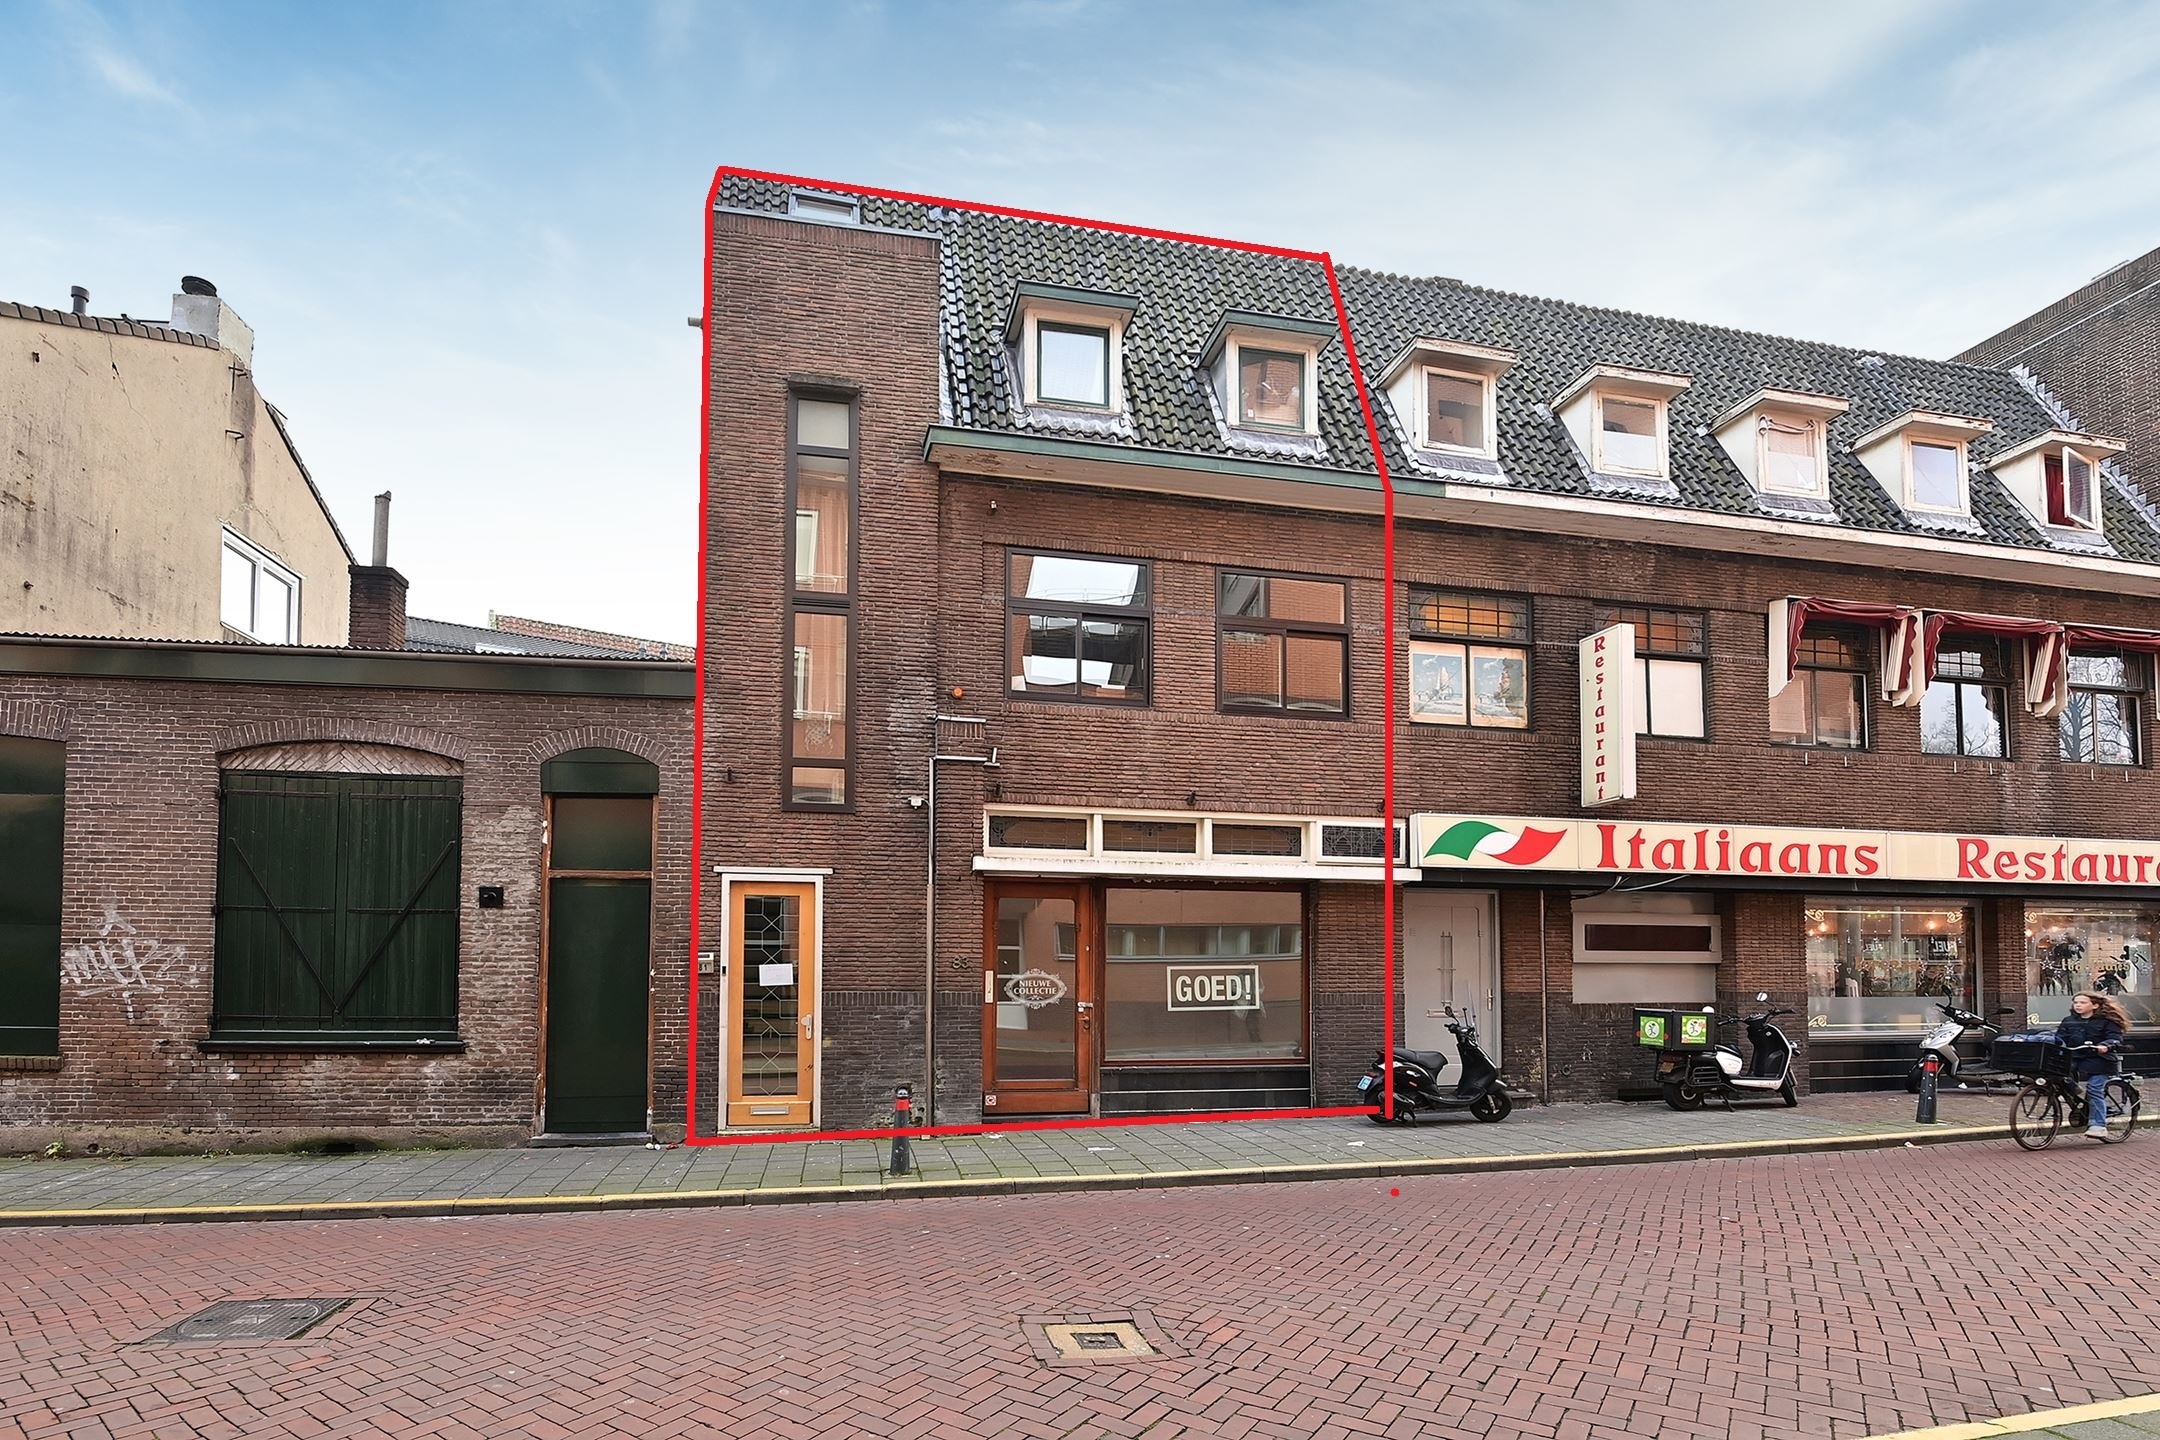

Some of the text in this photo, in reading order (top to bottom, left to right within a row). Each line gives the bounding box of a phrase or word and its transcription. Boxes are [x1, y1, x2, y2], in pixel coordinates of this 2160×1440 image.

[1594, 635, 1606, 800] Restaurant
[1596, 824, 1879, 876] Italiaans
[1013, 987, 1057, 995] COLLECTIE
[1175, 974, 1251, 1002] GOED!
